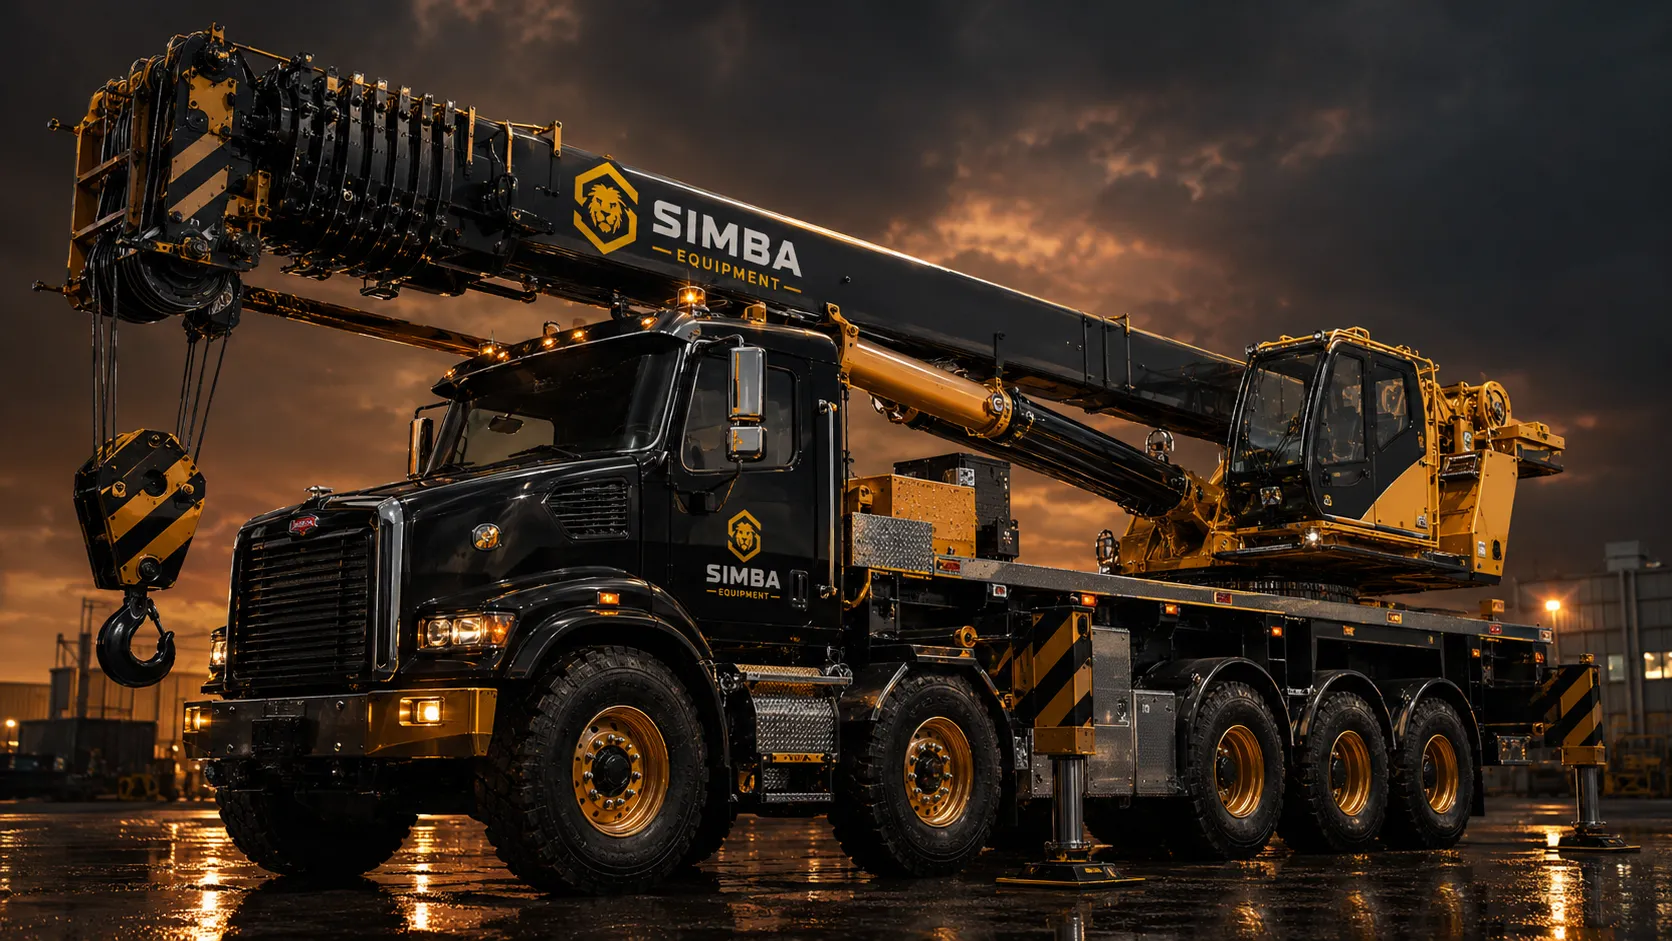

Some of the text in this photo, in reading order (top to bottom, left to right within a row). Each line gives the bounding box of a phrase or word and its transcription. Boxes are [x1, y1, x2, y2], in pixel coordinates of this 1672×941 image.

[652, 199, 802, 277] SIMBA
[677, 248, 780, 291] EQUIPMENT
[706, 563, 781, 589] SIMBA
[718, 588, 769, 600] EQUIPMENT
